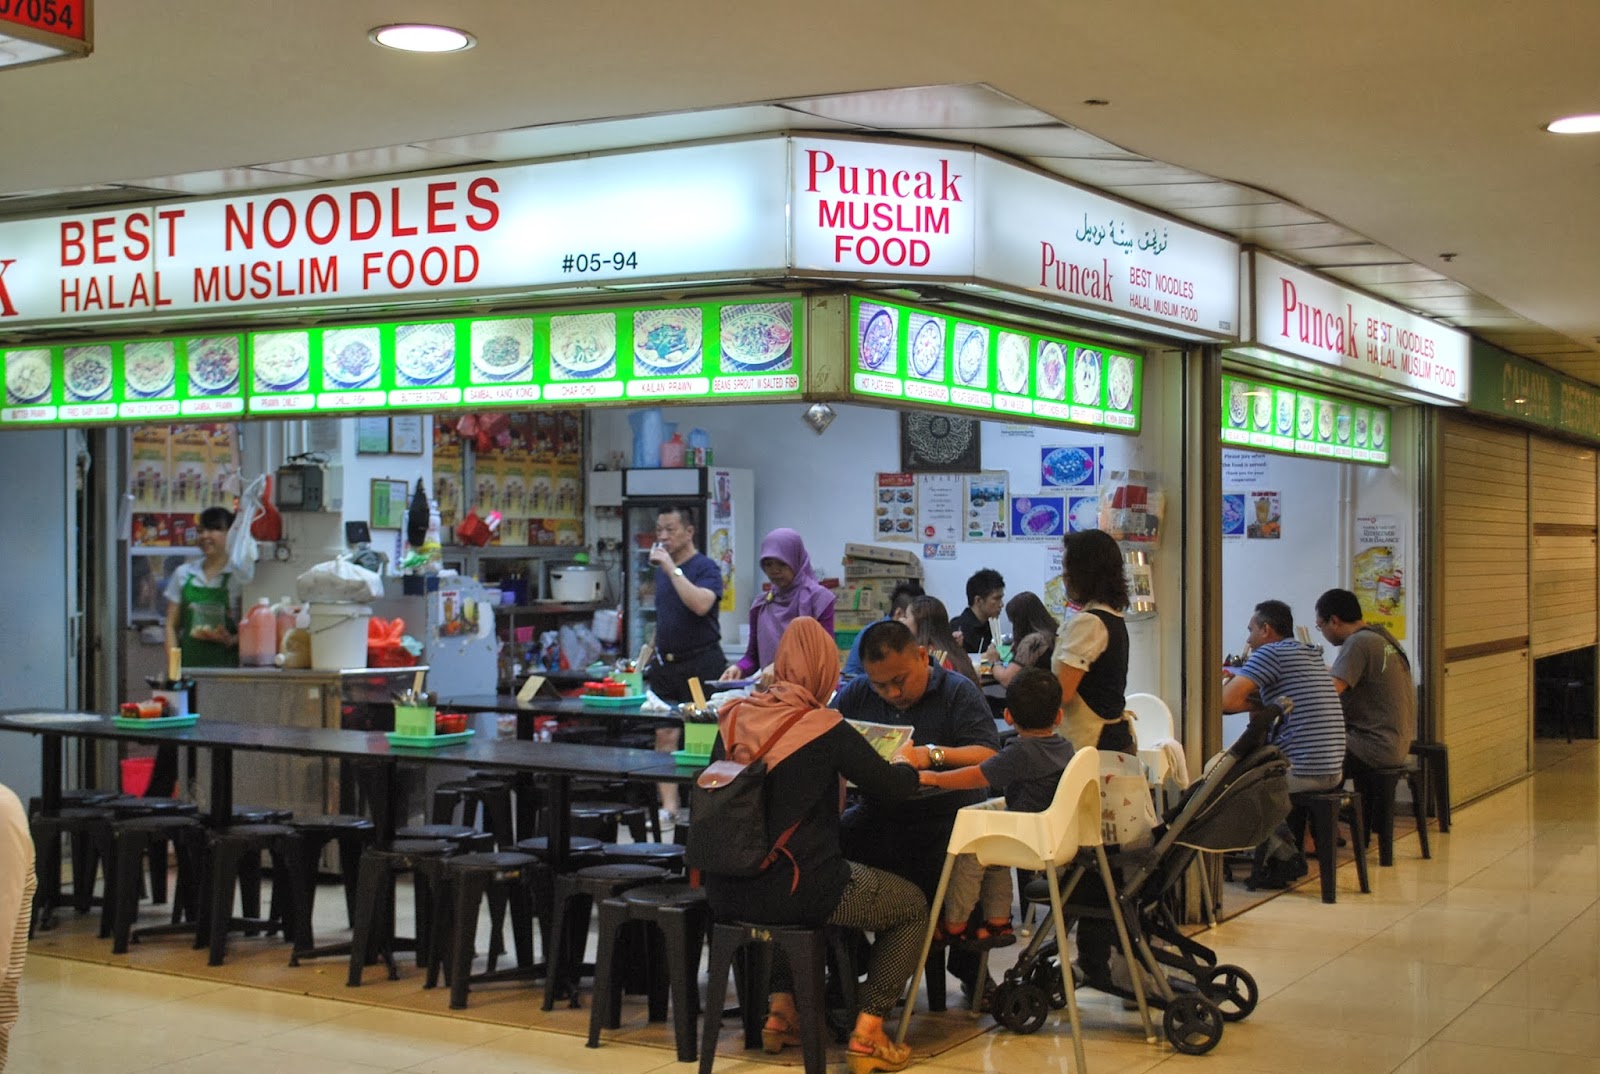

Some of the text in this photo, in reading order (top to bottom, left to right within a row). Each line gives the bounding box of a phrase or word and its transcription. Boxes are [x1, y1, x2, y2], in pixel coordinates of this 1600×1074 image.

[804, 149, 963, 202] Puncak
[60, 177, 499, 267] BEST NOODLES
[819, 199, 950, 234] MUSLIM
[562, 251, 639, 273] #05-94
[834, 235, 931, 268] FOOD
[1040, 240, 1114, 303] Puncak
[61, 244, 480, 313] HALAL MUSLIM FOOD
[1129, 266, 1194, 300] BEST NOODLES
[1129, 293, 1198, 323] HALAL MUSLIM FOOD
[1280, 277, 1359, 360] Puncak
[1366, 317, 1435, 360] BEST NOODLES
[1366, 341, 1456, 388] HALAL MUSLIM FOOD
